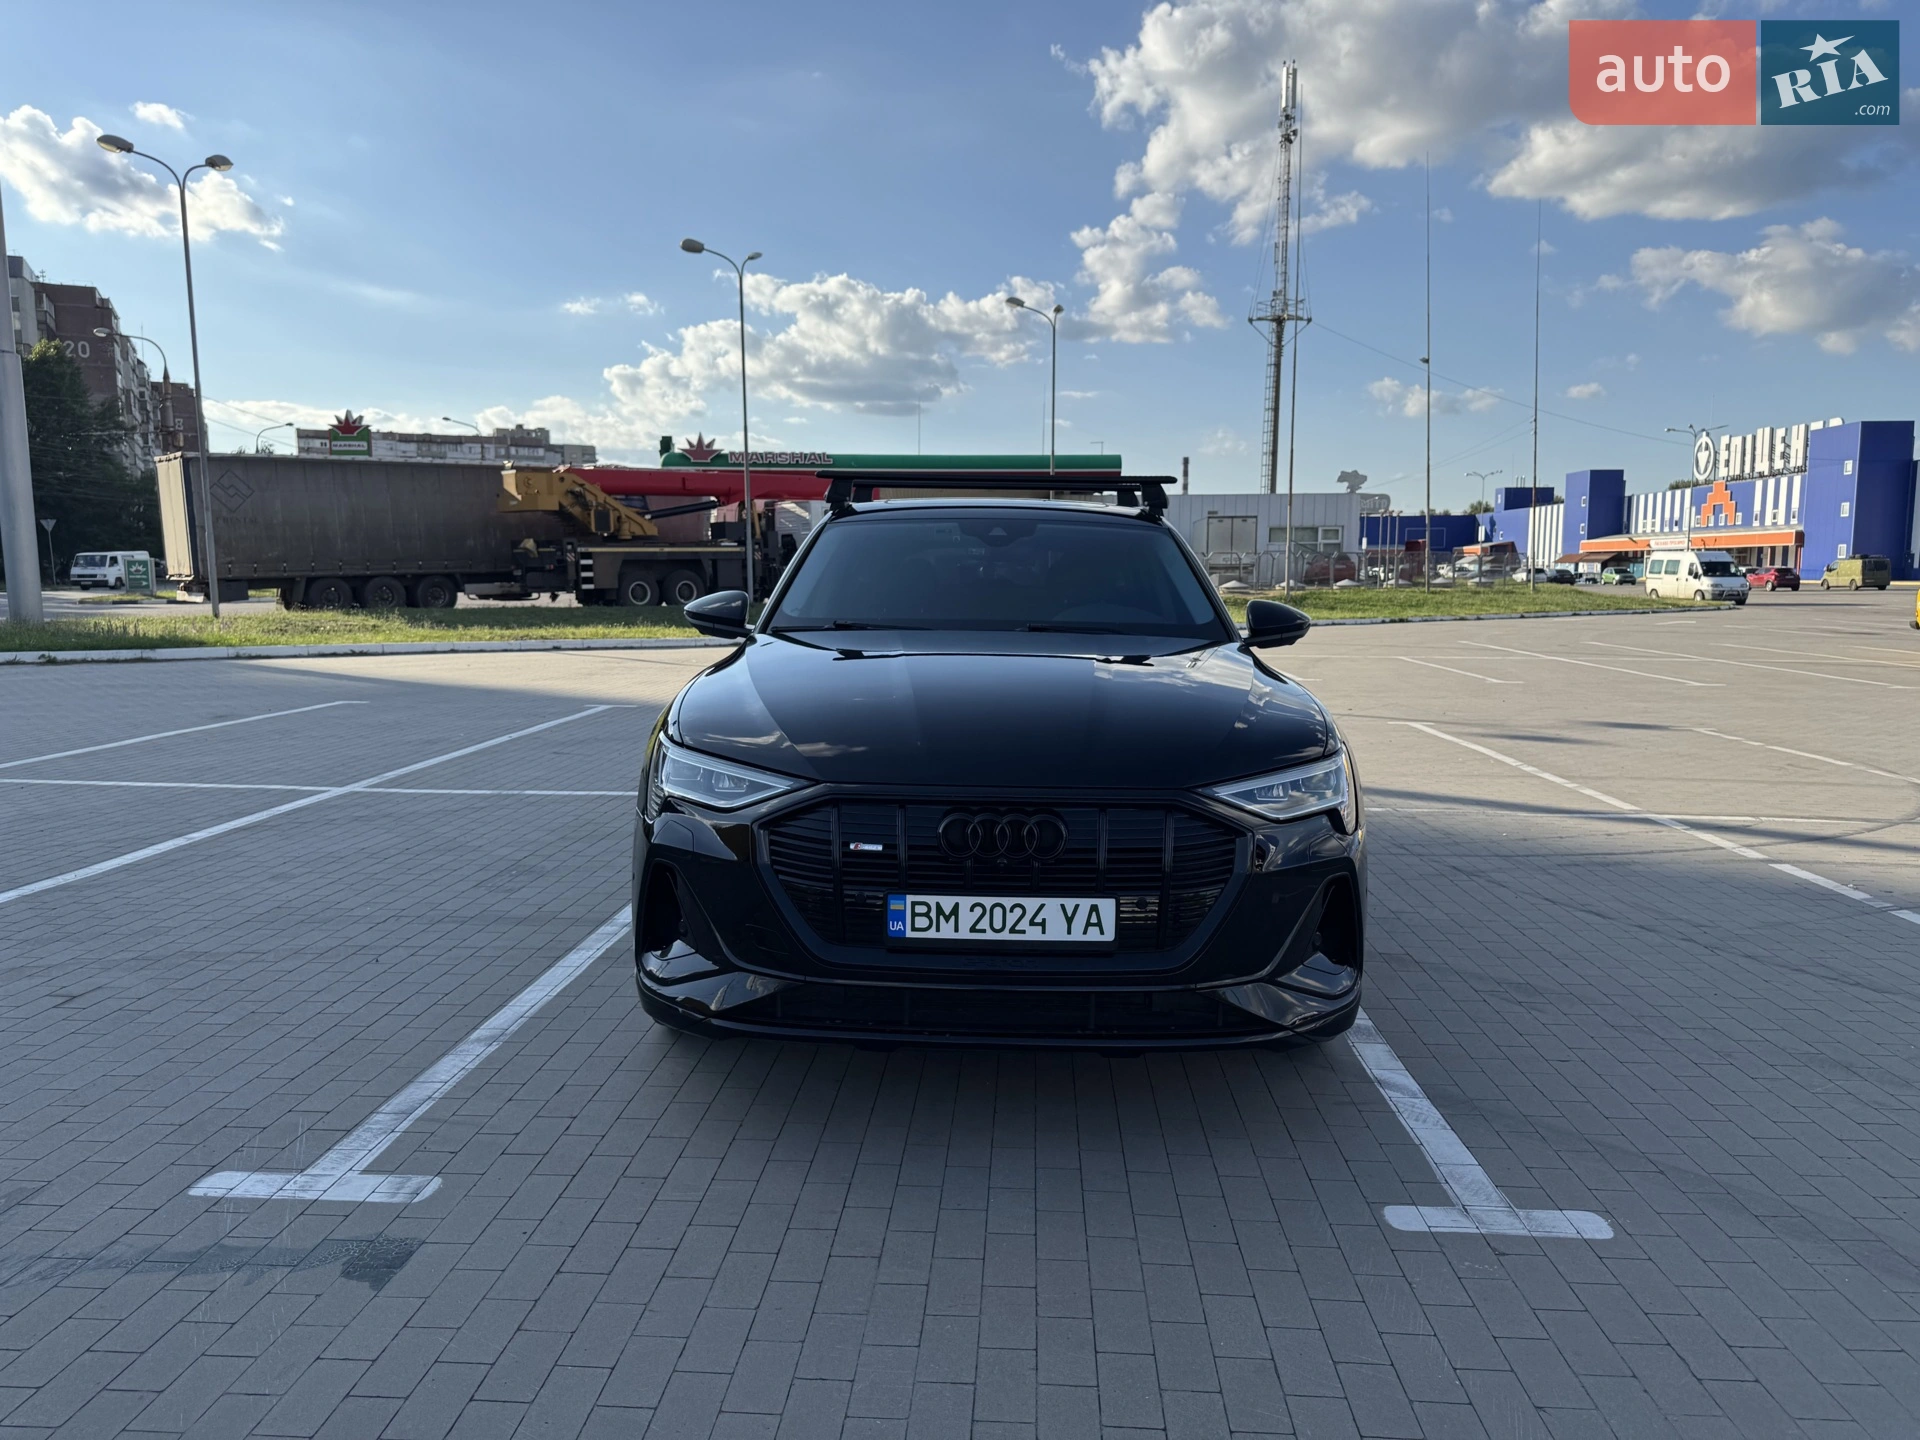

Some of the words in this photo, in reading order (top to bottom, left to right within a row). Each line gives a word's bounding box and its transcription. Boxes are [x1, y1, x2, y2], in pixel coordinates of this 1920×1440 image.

[63, 340, 91, 359] 20
[1718, 417, 1843, 477] ЕПІЦЕН
[728, 451, 833, 464] MARSHAL
[889, 920, 904, 931] UA
[910, 900, 960, 933] BM
[969, 902, 1047, 935] 2024
[1060, 903, 1105, 936] YA
